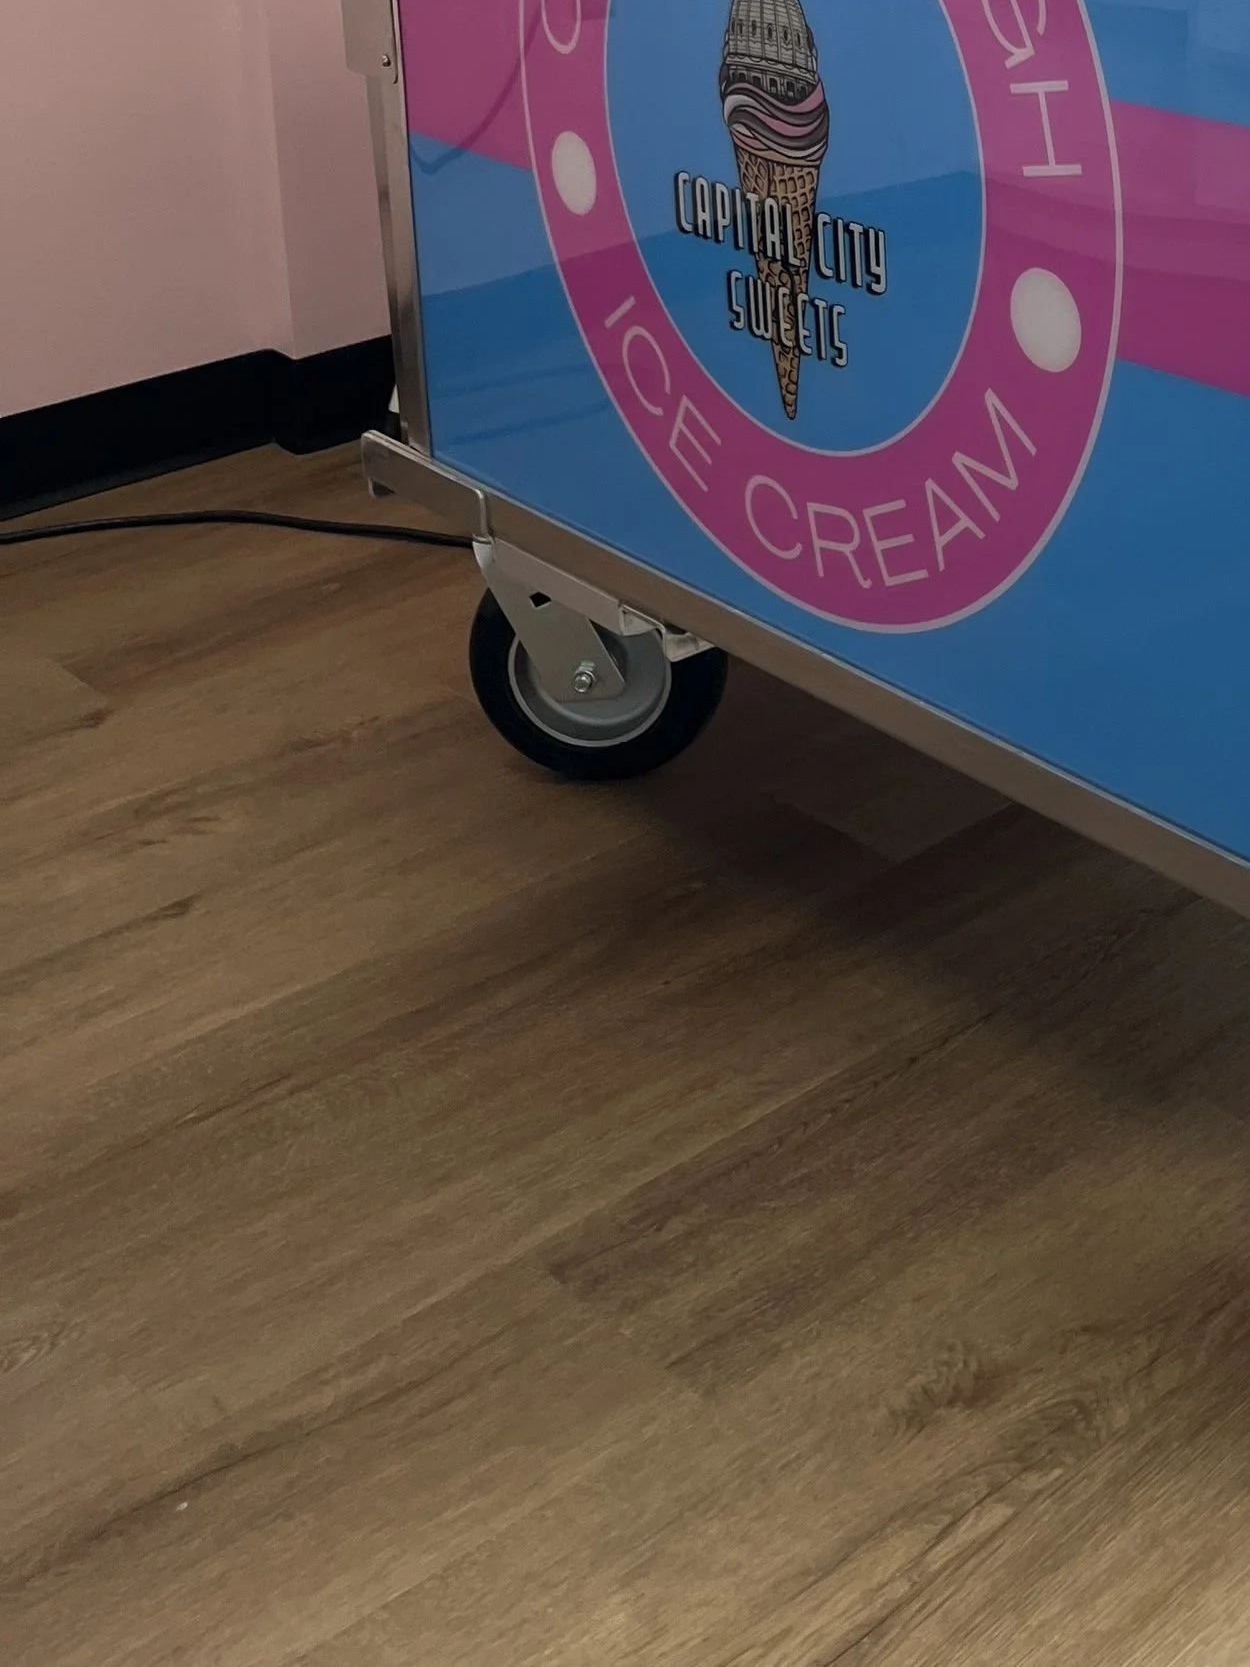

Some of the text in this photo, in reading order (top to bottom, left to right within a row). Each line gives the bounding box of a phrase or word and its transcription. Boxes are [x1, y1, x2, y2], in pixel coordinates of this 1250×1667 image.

[674, 170, 887, 294] CAPITAL CITY
[727, 270, 849, 368] SWEETS
[604, 295, 1037, 588] ICE CREAM
